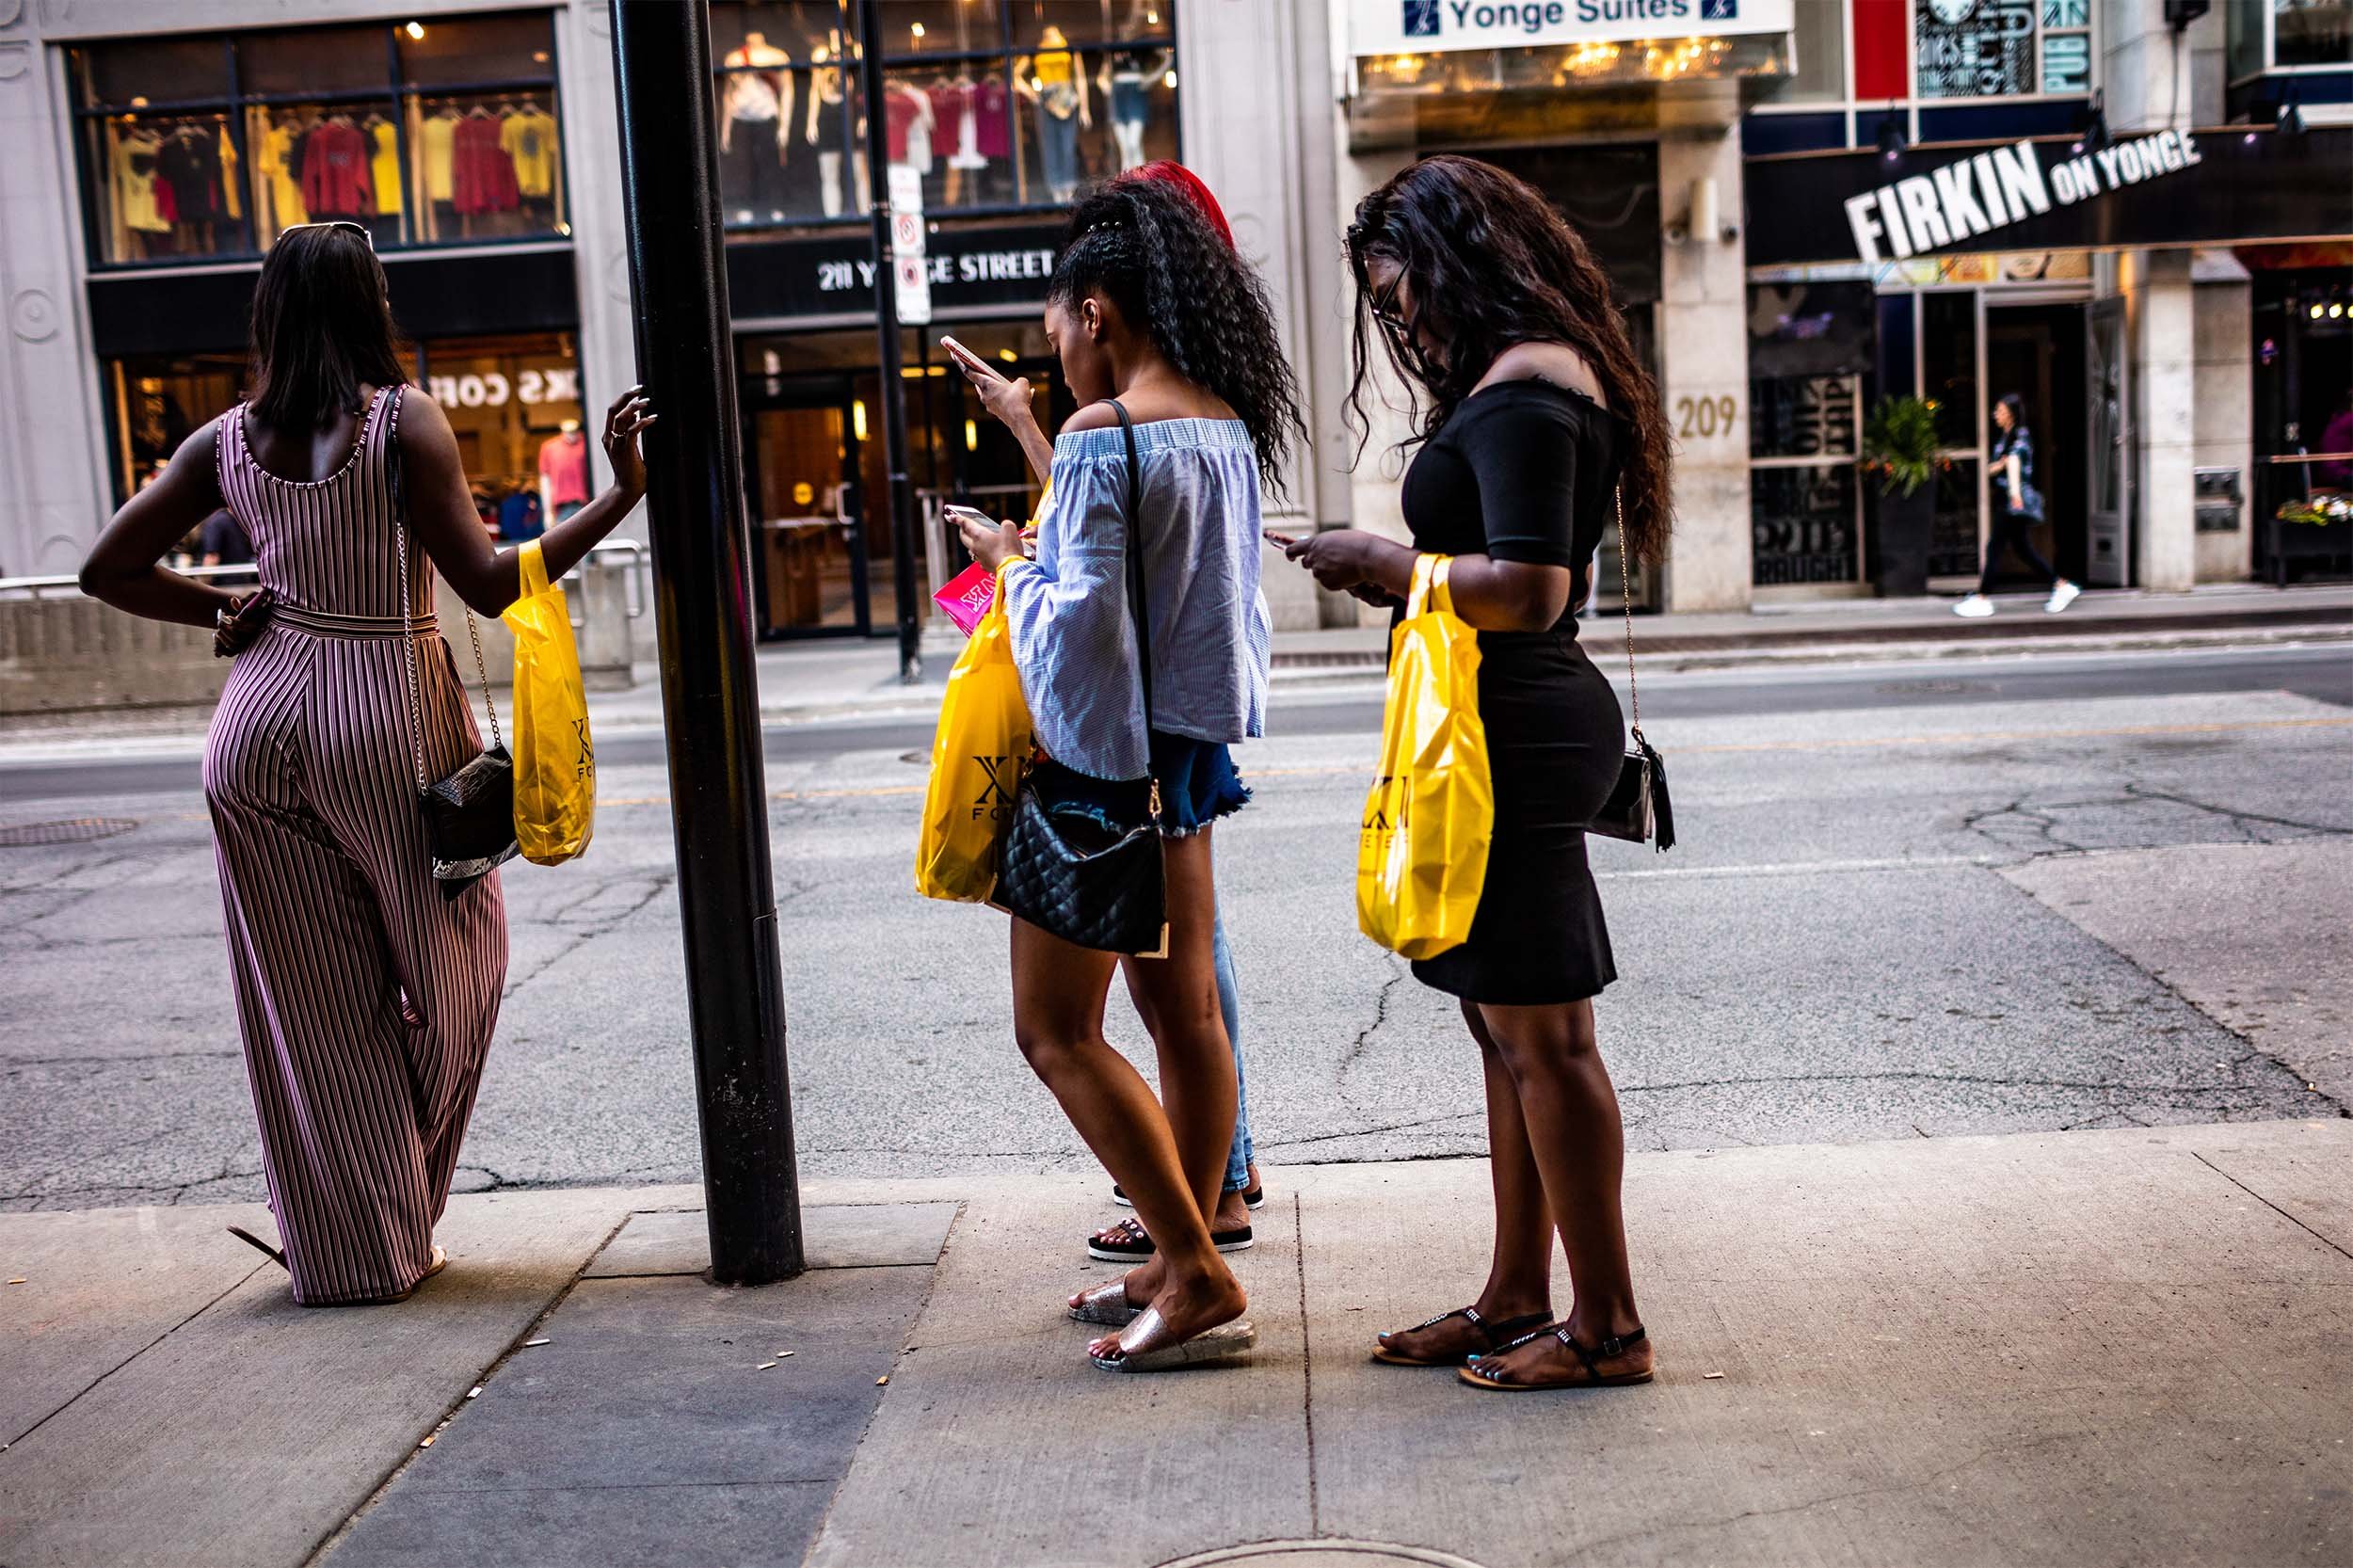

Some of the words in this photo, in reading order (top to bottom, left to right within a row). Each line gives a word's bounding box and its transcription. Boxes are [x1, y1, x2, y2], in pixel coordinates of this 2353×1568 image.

[1449, 0, 1563, 32] Yonge
[1577, 0, 1689, 23] Suites
[1844, 139, 2051, 262] FIRKIN
[2050, 155, 2100, 205] ON
[2095, 127, 2202, 190] YONGE
[960, 249, 1055, 282] STREET
[1676, 396, 1737, 439] 209
